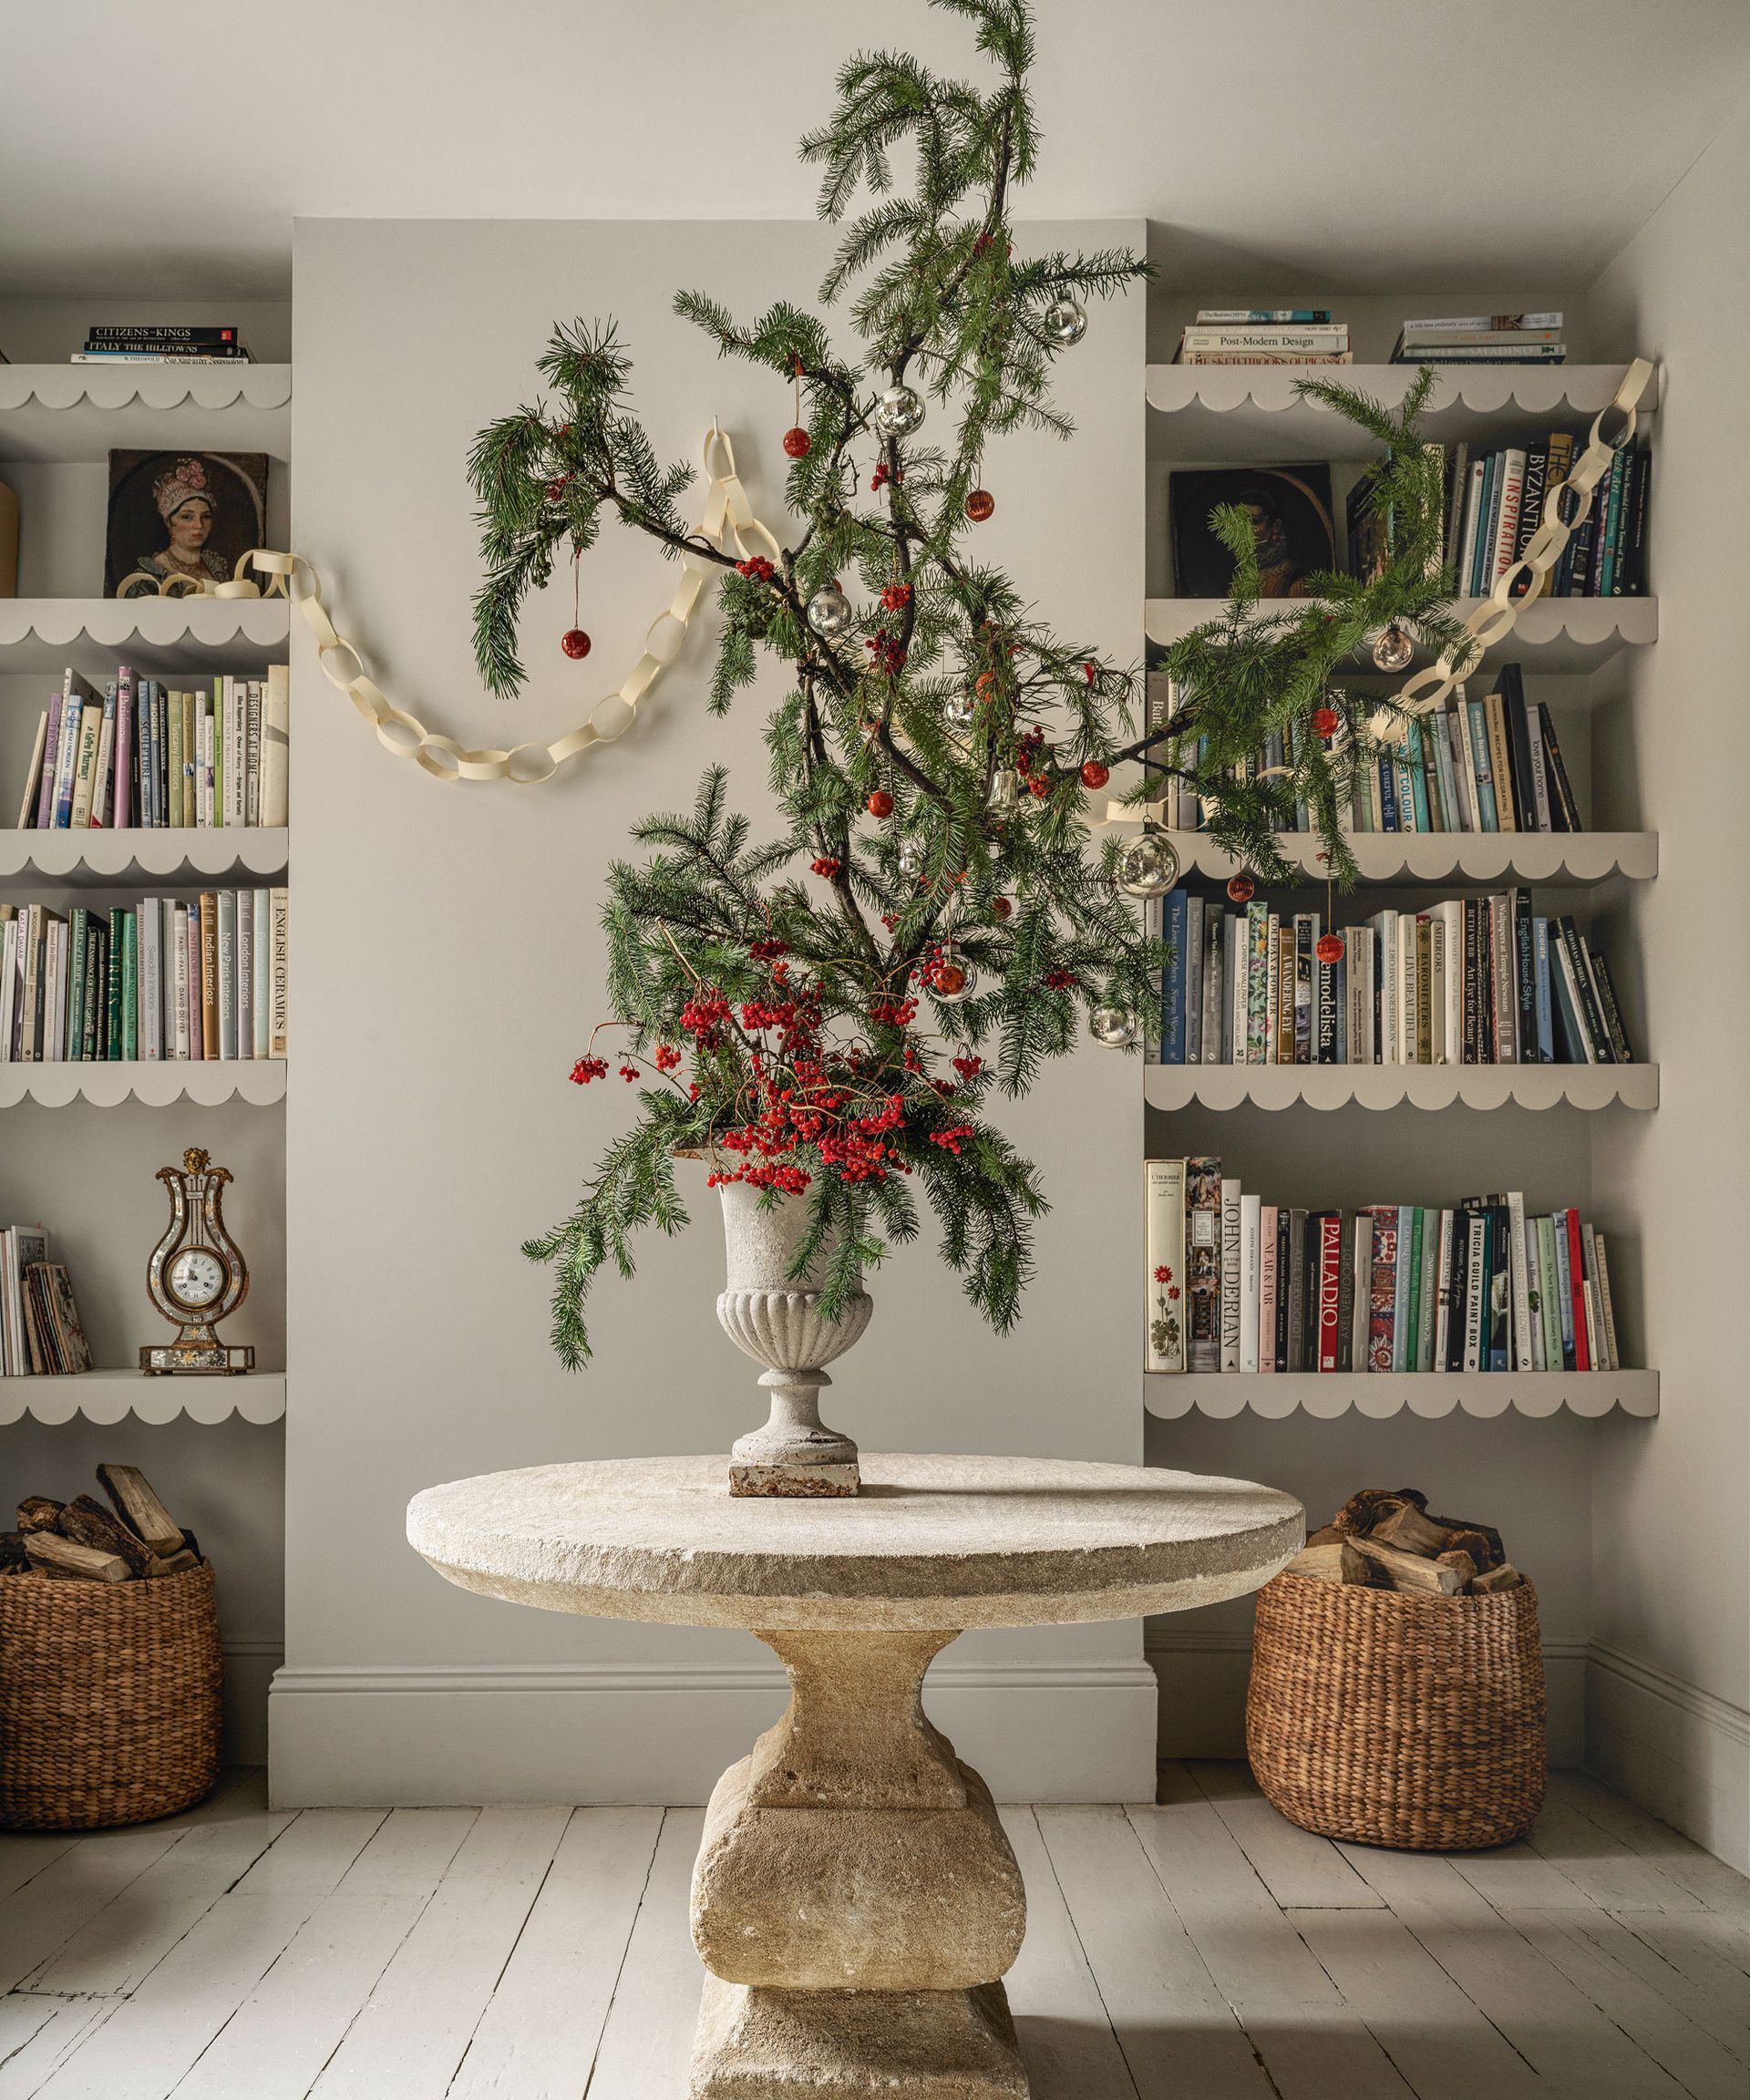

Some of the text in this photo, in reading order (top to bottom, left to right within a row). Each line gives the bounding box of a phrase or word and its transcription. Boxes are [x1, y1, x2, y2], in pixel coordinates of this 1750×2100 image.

[96, 328, 190, 336] CITIZENS KINGS
[146, 345, 197, 353] HILLTOWNS
[1220, 337, 1312, 347] Post-Modern Design
[1549, 445, 1570, 477] THE
[1611, 451, 1624, 494] Folk Art
[1621, 483, 1630, 506] Beautiful
[1498, 478, 1521, 575] INSPIRATION
[1619, 508, 1628, 529] Country
[119, 695, 129, 744] Parisiennes
[150, 704, 159, 740] MODERN
[248, 694, 258, 775] DESIGNERS AT HOME
[1475, 710, 1487, 768] dream homes
[46, 724, 57, 759] FRENCH
[141, 721, 150, 779] SCULPTURE
[171, 723, 180, 790] Tuscany Interiors
[98, 746, 108, 788] COLLECTING
[1533, 741, 1545, 798] love your home
[1399, 778, 1412, 821] COLOUR
[1498, 775, 1508, 812] DECORATING
[1270, 918, 1278, 962] COLEFAX
[1498, 904, 1508, 944] Wallpapers
[1539, 923, 1548, 959] Decorate
[109, 953, 119, 1004] TREES
[148, 946, 156, 978] Swedish
[205, 933, 214, 1005] Indian Interiors
[222, 932, 232, 1020] New Paris Interiors
[241, 932, 250, 1008] London Interiors
[275, 909, 285, 1029] ENGLISH CERAMICS
[1467, 966, 1475, 979] An
[1498, 953, 1509, 978] Temple
[1518, 918, 1532, 1010] English House Style
[1567, 930, 1588, 988] THOMAS O'BRIEN
[148, 981, 156, 1010] Interiors
[1270, 974, 1278, 1014] FOWLER
[1282, 962, 1292, 1014] WANDERING
[1321, 962, 1335, 1048] emodelista
[1405, 956, 1415, 1042] LIVE BEAUTIFUL
[1465, 983, 1475, 996] Eye
[1467, 1000, 1476, 1013] for
[1501, 982, 1509, 1013] Newsam
[1282, 1017, 1292, 1034] EYE
[1466, 1015, 1477, 1045] Beauty
[1402, 1226, 1411, 1263] GEOFFREY
[1514, 1214, 1522, 1239] LAND
[1224, 1199, 1240, 1349] JOHN DERIAN
[1323, 1223, 1340, 1327] PALLADIO
[1410, 1225, 1421, 1323] Classic Swedish Interiors
[1469, 1225, 1482, 1348] TRICIA GUILD PAINT BOX
[1515, 1241, 1525, 1290] GARDENERS
[1292, 1248, 1302, 1340] AXEL VERVOORDT
[1518, 1292, 1527, 1309] CUT
[1519, 1311, 1528, 1348] FLOWERS
[1550, 1338, 1559, 1350] Style
